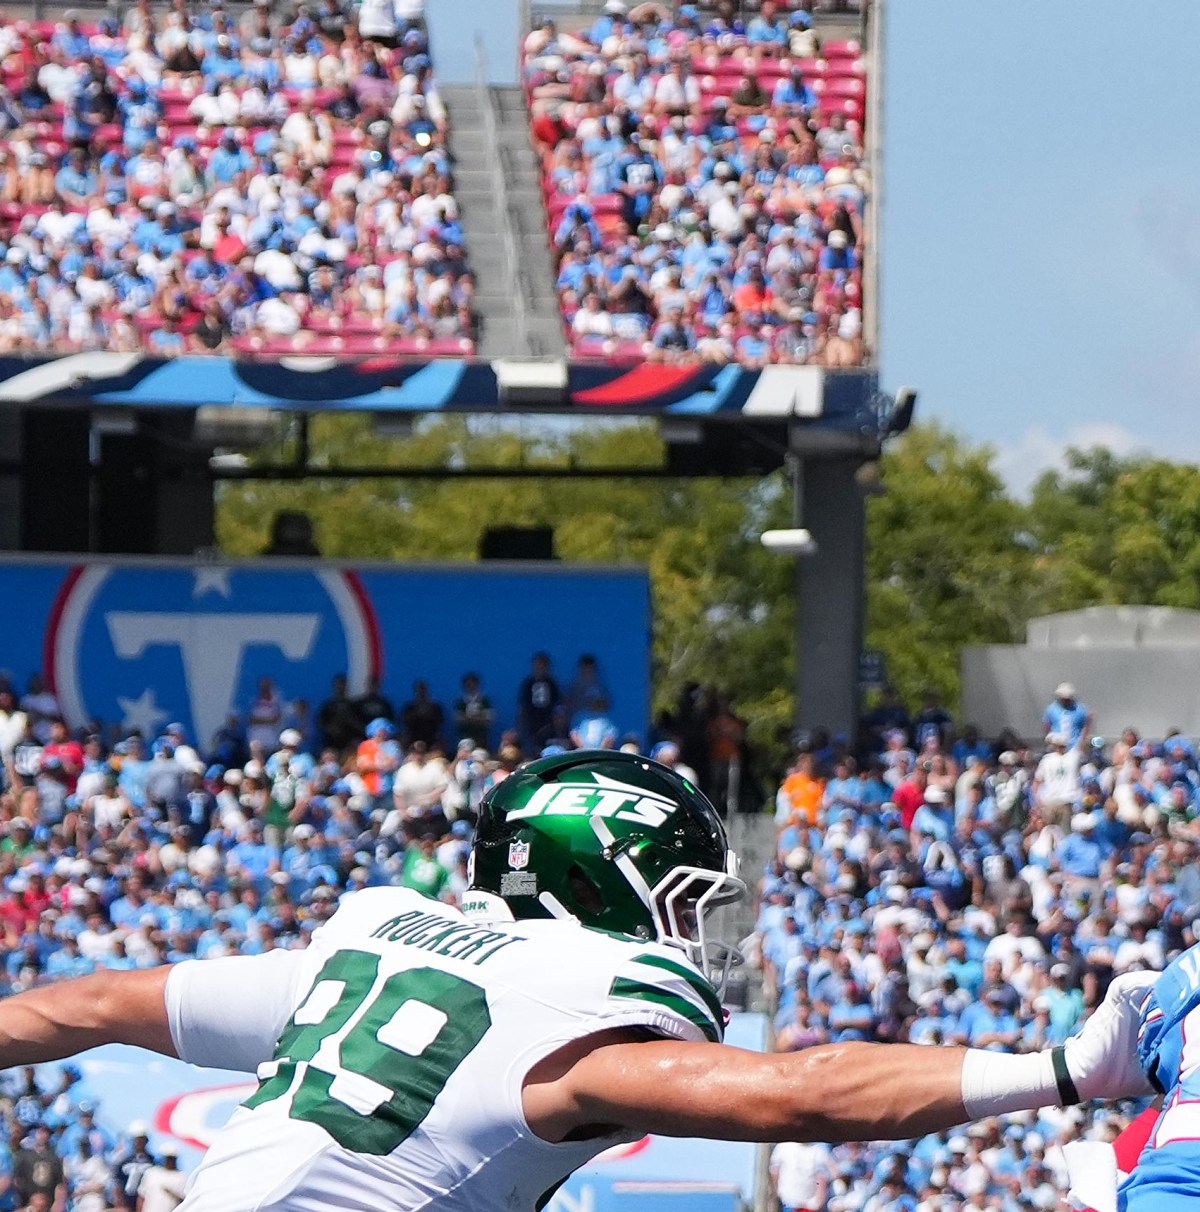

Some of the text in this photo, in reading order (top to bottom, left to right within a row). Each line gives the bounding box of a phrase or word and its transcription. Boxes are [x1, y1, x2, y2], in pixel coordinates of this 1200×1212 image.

[506, 772, 679, 828] JETS
[461, 901, 488, 912] ORK
[370, 910, 528, 966] RUCKERT
[239, 949, 492, 1157] 89
